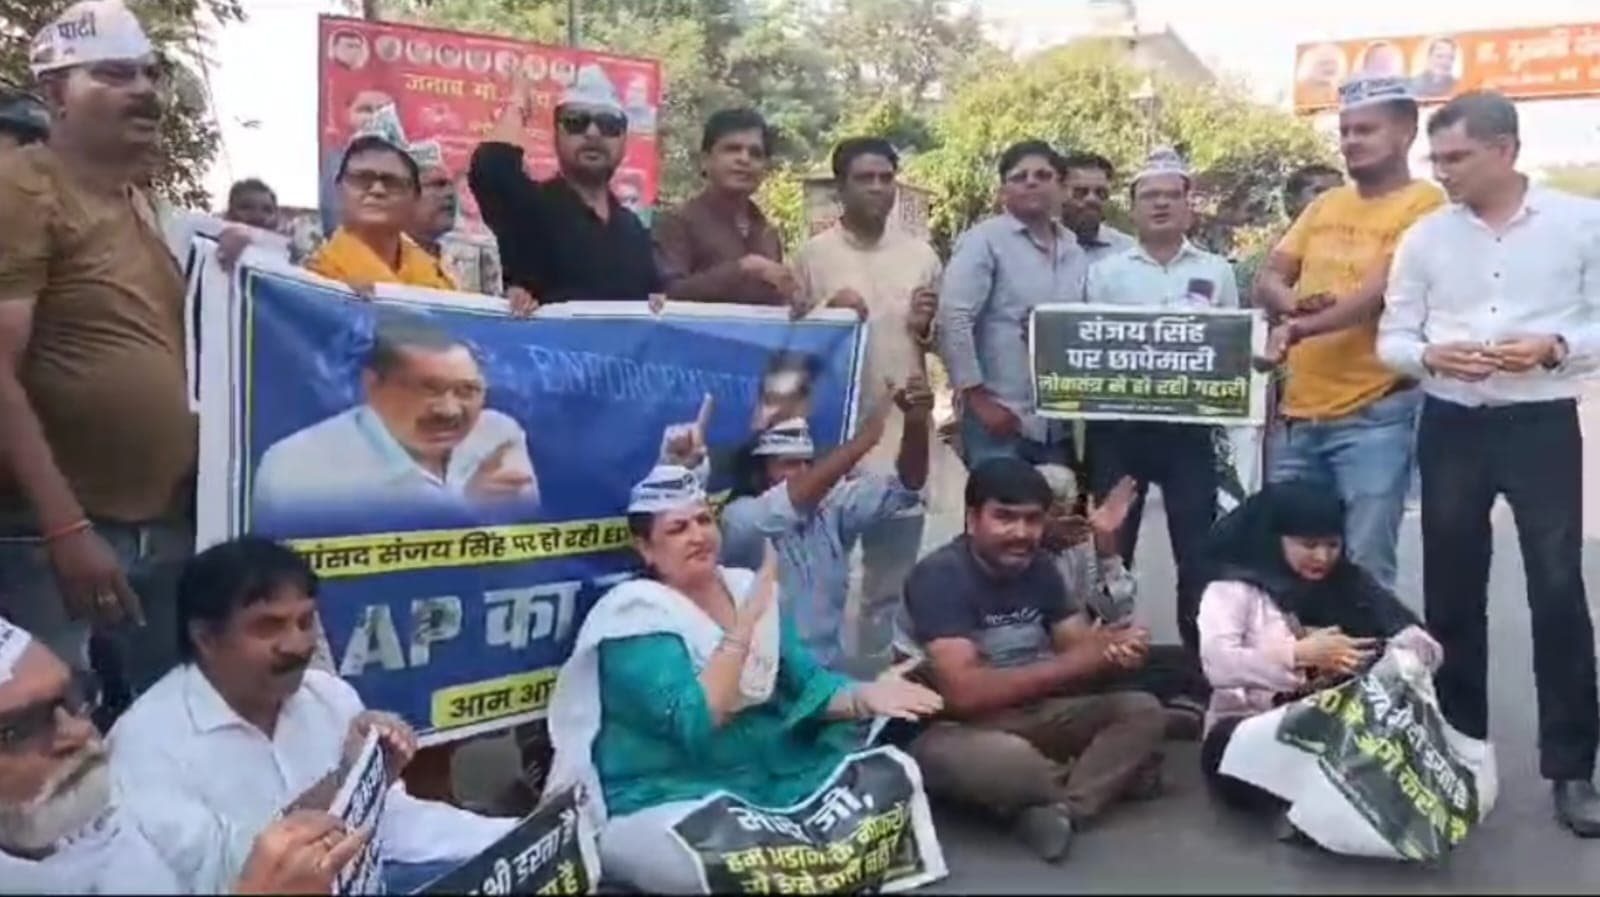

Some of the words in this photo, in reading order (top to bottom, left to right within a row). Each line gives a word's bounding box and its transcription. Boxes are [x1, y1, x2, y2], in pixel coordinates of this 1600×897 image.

[405, 75, 465, 97] जनाब
[1078, 315, 1148, 342] संजय
[1153, 315, 1206, 342] सिंह
[1066, 347, 1103, 369] पर
[1107, 345, 1217, 372] छापेमारी
[1037, 374, 1104, 393] लोकतंत्र
[1132, 375, 1151, 395] हो
[1156, 375, 1189, 397] रही
[375, 537, 454, 564] संजय
[459, 530, 507, 558] सिंह
[512, 534, 537, 553] पर
[538, 528, 563, 552] हो
[564, 523, 599, 548] रही
[484, 580, 582, 650] का
[449, 686, 514, 718] आम
[512, 826, 561, 884] डरता
[559, 808, 576, 845] है
